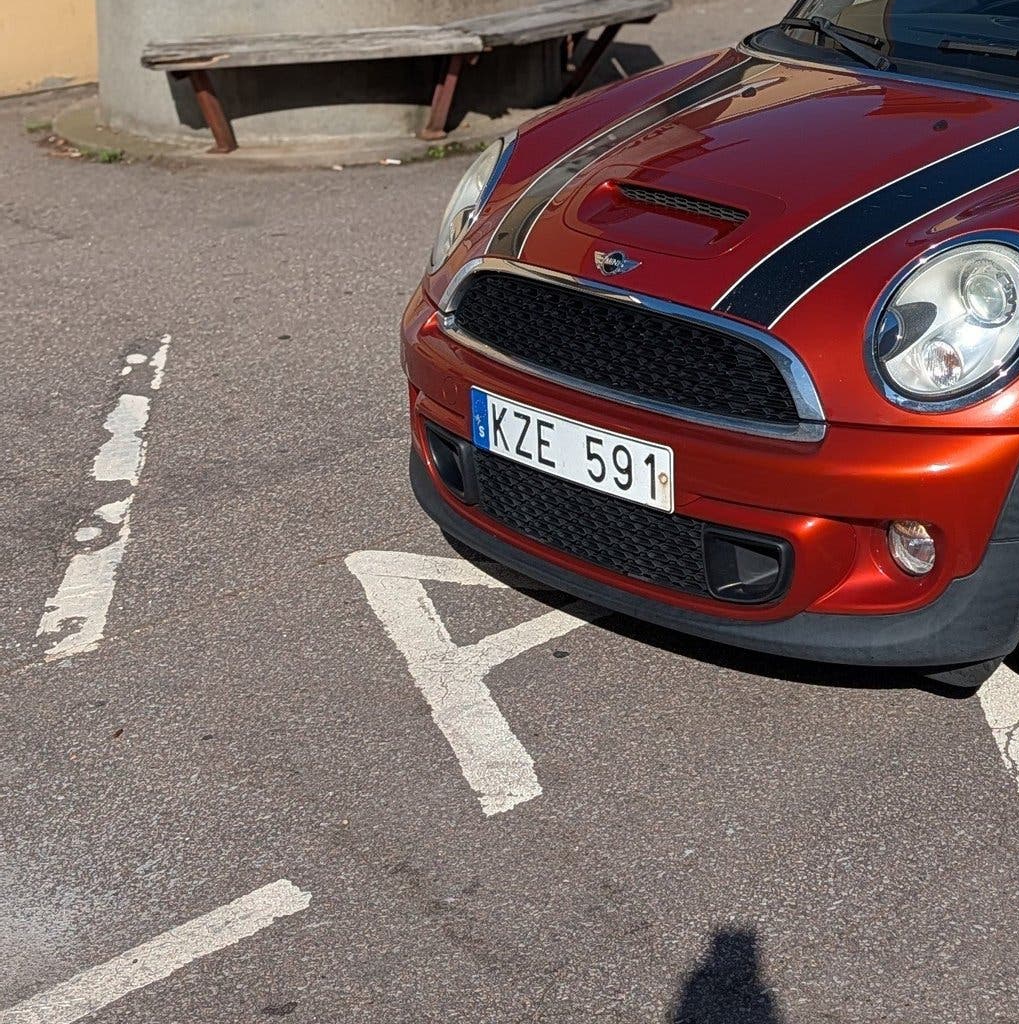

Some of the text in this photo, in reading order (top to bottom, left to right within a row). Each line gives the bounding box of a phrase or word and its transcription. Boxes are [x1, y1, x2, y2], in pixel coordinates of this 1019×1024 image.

[478, 425, 485, 438] S
[491, 403, 657, 501] KZE 591
